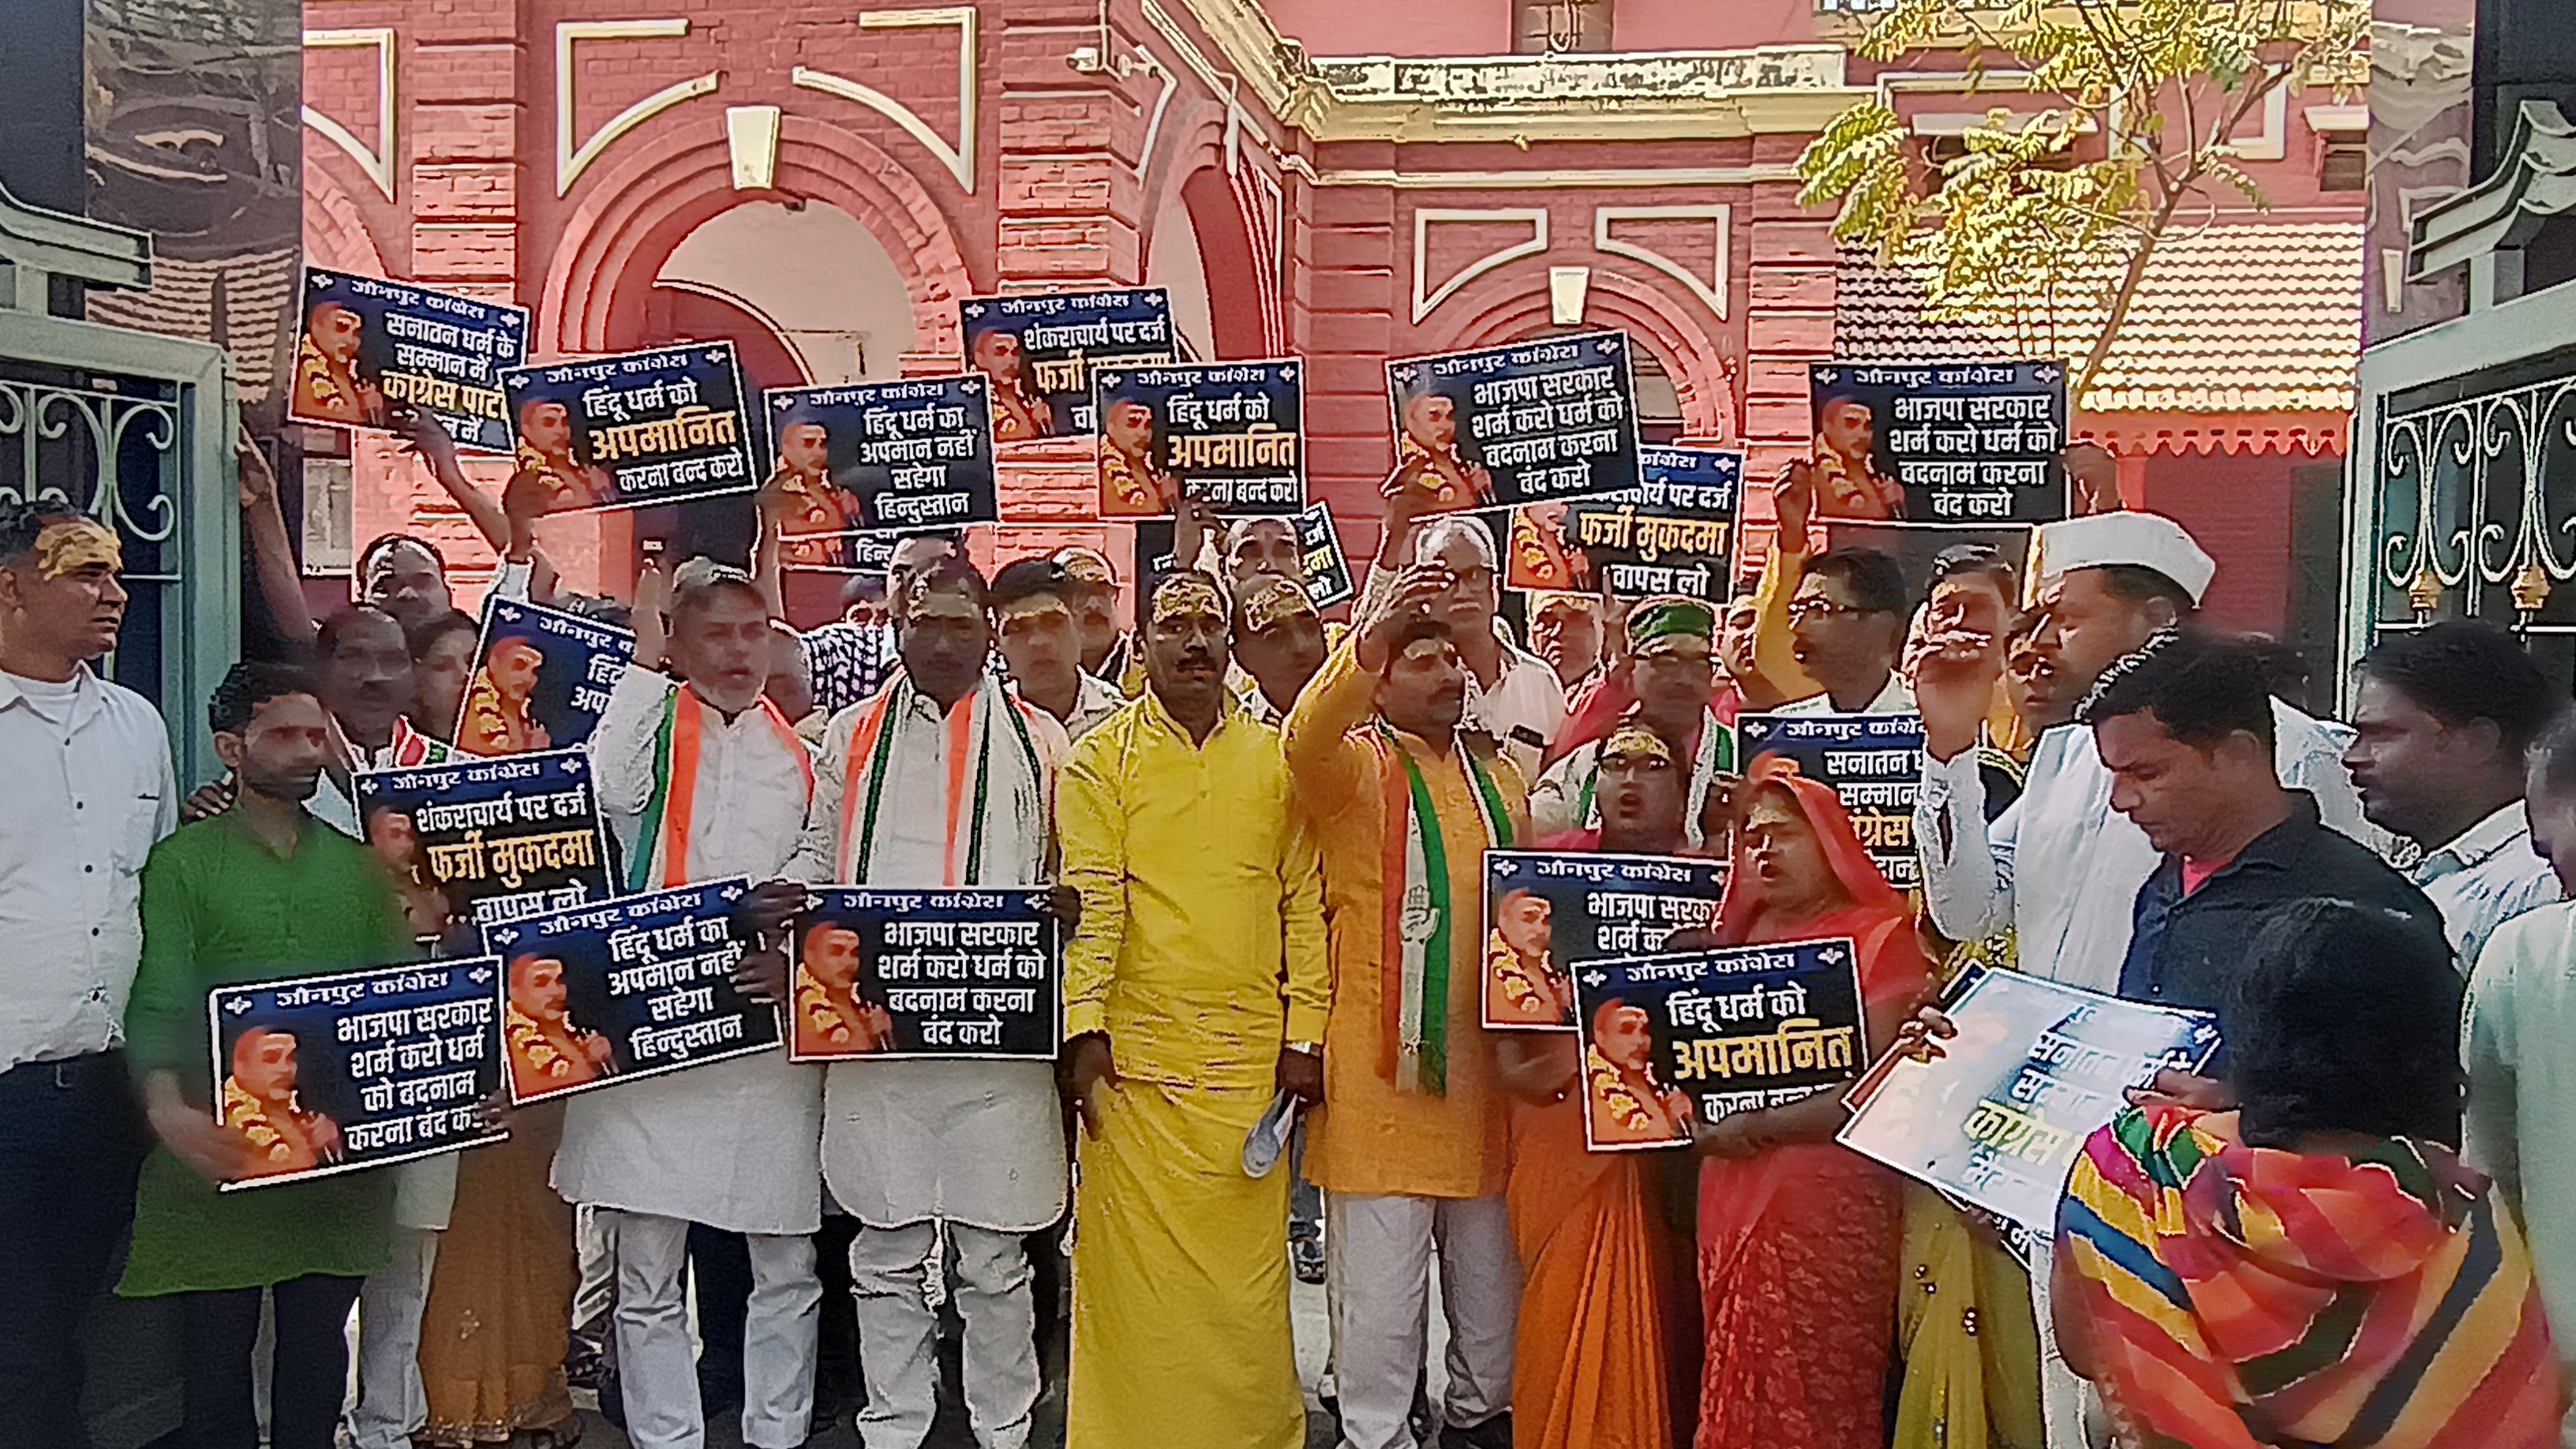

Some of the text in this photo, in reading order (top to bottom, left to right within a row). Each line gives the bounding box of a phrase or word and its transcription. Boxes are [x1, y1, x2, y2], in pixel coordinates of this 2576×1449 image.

[385, 313, 518, 358] सनातन धर्म के
[1110, 323, 1136, 343] पर
[1135, 314, 1166, 341] दर्ज
[395, 343, 492, 380] सम्मान में
[1032, 349, 1085, 393] फर्जी
[380, 368, 459, 410] कांग्रेस
[582, 376, 698, 421] हिंदू धर्म को
[1474, 365, 1615, 405] भाजपा सरकार
[863, 402, 964, 440] हिंदू धर्म का
[1166, 391, 1269, 429] हिंदू धर्म को
[1472, 390, 1625, 438] शर्म करो धर्म को
[1895, 395, 2051, 421] भाजपा सरकार
[590, 405, 736, 460] अपमानित
[860, 429, 978, 463] अपमान नहीं
[1168, 423, 1297, 468] अपमानित
[1557, 429, 1618, 458] करना
[1890, 421, 2058, 453] शर्म करो धर्म को
[616, 464, 669, 492] करना
[708, 447, 743, 478] करो
[891, 462, 946, 489] सहेगा
[1234, 477, 1267, 503] बन्द
[1267, 470, 1297, 502] करो
[1548, 459, 1591, 490] करो
[1979, 461, 2047, 485] करना
[874, 492, 969, 523] हिन्दुस्तान
[1668, 484, 1696, 507] पर
[1698, 481, 1732, 510] दर्ज
[1966, 487, 2013, 515] करो
[1580, 504, 1728, 561] फर्जी मुकदमा
[1611, 563, 1710, 596] वापस लो
[1825, 751, 1911, 775] सनातन
[416, 783, 587, 832] शंकराचार्य पर दर्ज
[1837, 783, 1922, 806] सम्मान
[427, 829, 595, 888] फर्जी मुकदमा
[548, 878, 587, 912] लो
[1587, 892, 1656, 919] भाजपा
[608, 915, 728, 964] हिंदू धर्म का
[884, 922, 1040, 946] भाजपा सरकार
[1598, 919, 1639, 952] शर्म
[608, 957, 697, 995] अपमान
[878, 948, 1047, 979] शर्म करो धर्म को
[648, 987, 713, 1021] सहेगा
[886, 988, 1035, 1013] बदनाम करना
[1666, 981, 1807, 1032] हिंदू धर्म को
[337, 998, 493, 1043] भाजपा सरकार
[629, 1014, 742, 1060] हिन्दुस्तान
[957, 1013, 1003, 1045] करो
[351, 1026, 485, 1078] शर्म करो धर्म
[1672, 1018, 1853, 1080] अपमानित
[361, 1070, 476, 1111] को बदनाम
[344, 1117, 414, 1151] करना
[415, 1107, 450, 1138] बंद
